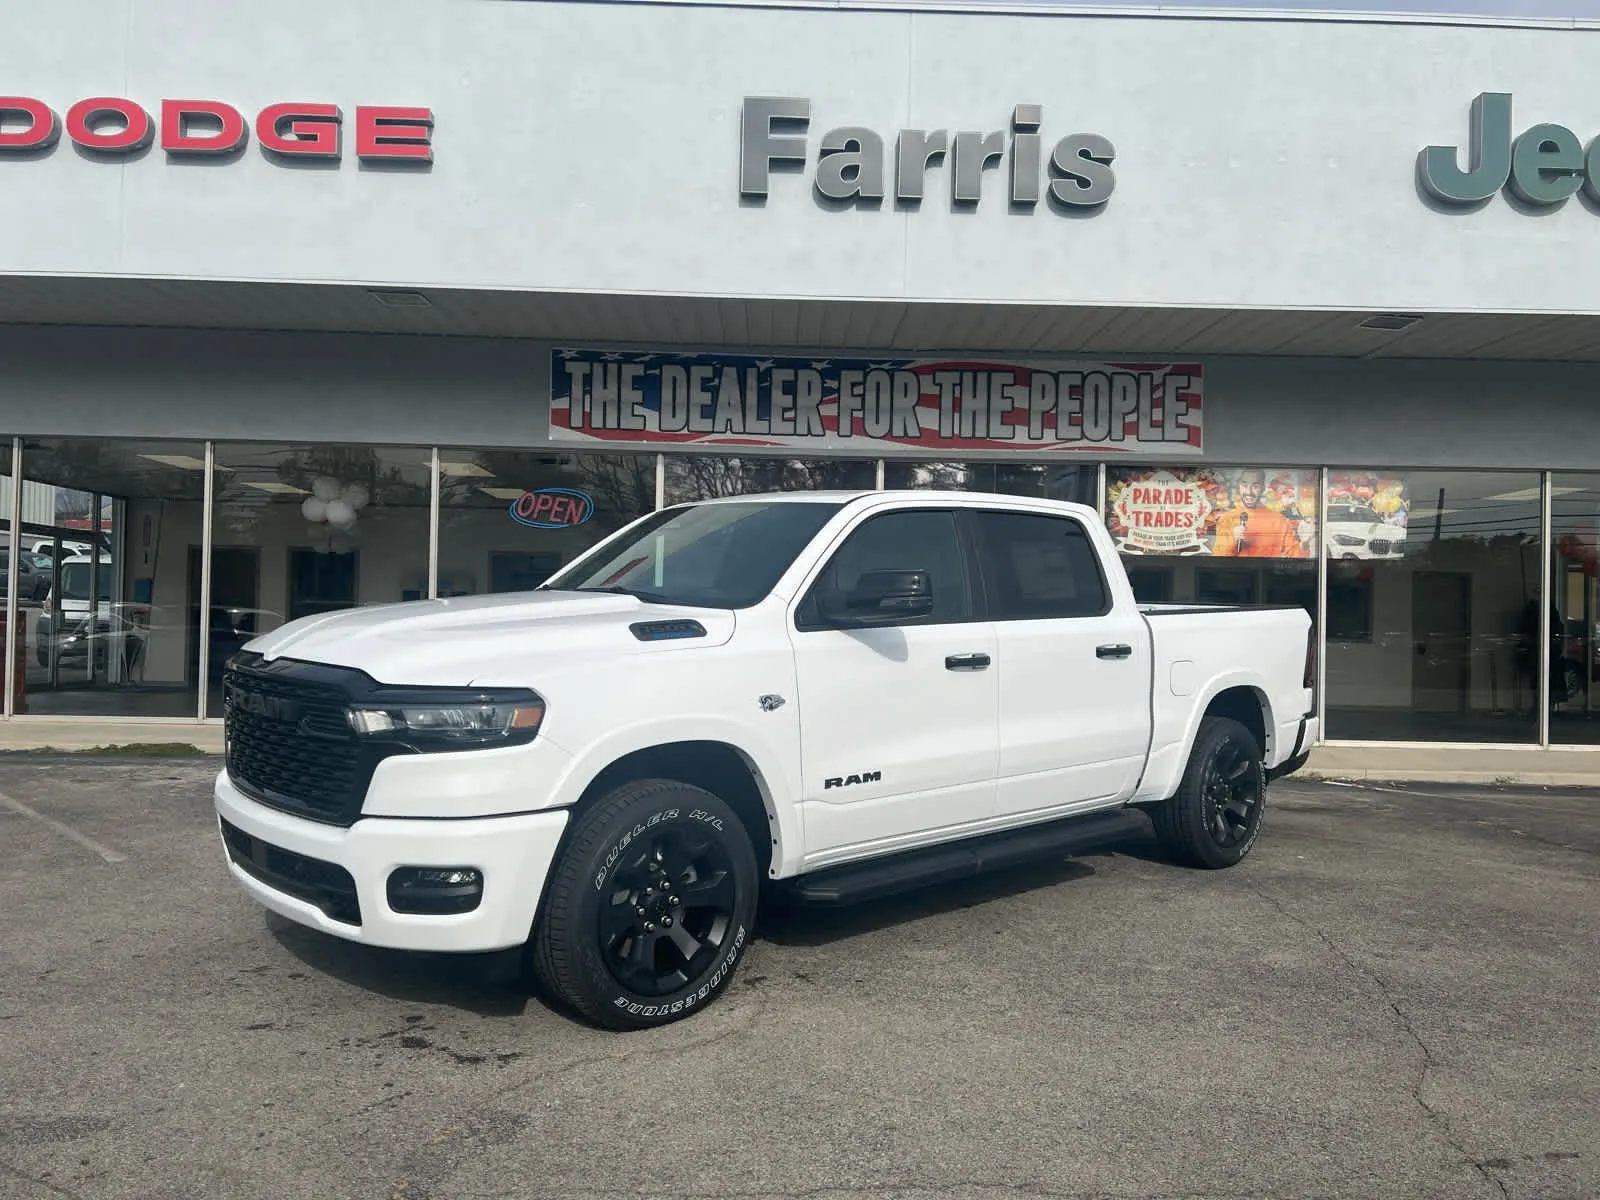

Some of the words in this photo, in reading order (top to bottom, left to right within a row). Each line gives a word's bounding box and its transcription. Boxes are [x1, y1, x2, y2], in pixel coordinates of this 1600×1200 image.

[0, 96, 434, 166] DODGE
[740, 95, 1118, 209] Farris
[1415, 92, 1600, 208] Je
[564, 359, 647, 431] THE
[658, 363, 826, 437] DEALER
[837, 367, 921, 439] FOR
[932, 369, 1016, 440] THE
[1027, 370, 1191, 442] PEOPLE
[516, 490, 586, 527] OPEN
[1132, 487, 1194, 505] PARADE
[1132, 510, 1194, 528] TRADES
[823, 770, 882, 789] RAM
[594, 808, 680, 892] DUELER
[689, 808, 724, 832] H/L
[613, 923, 747, 1016] BRIDGESTONE
